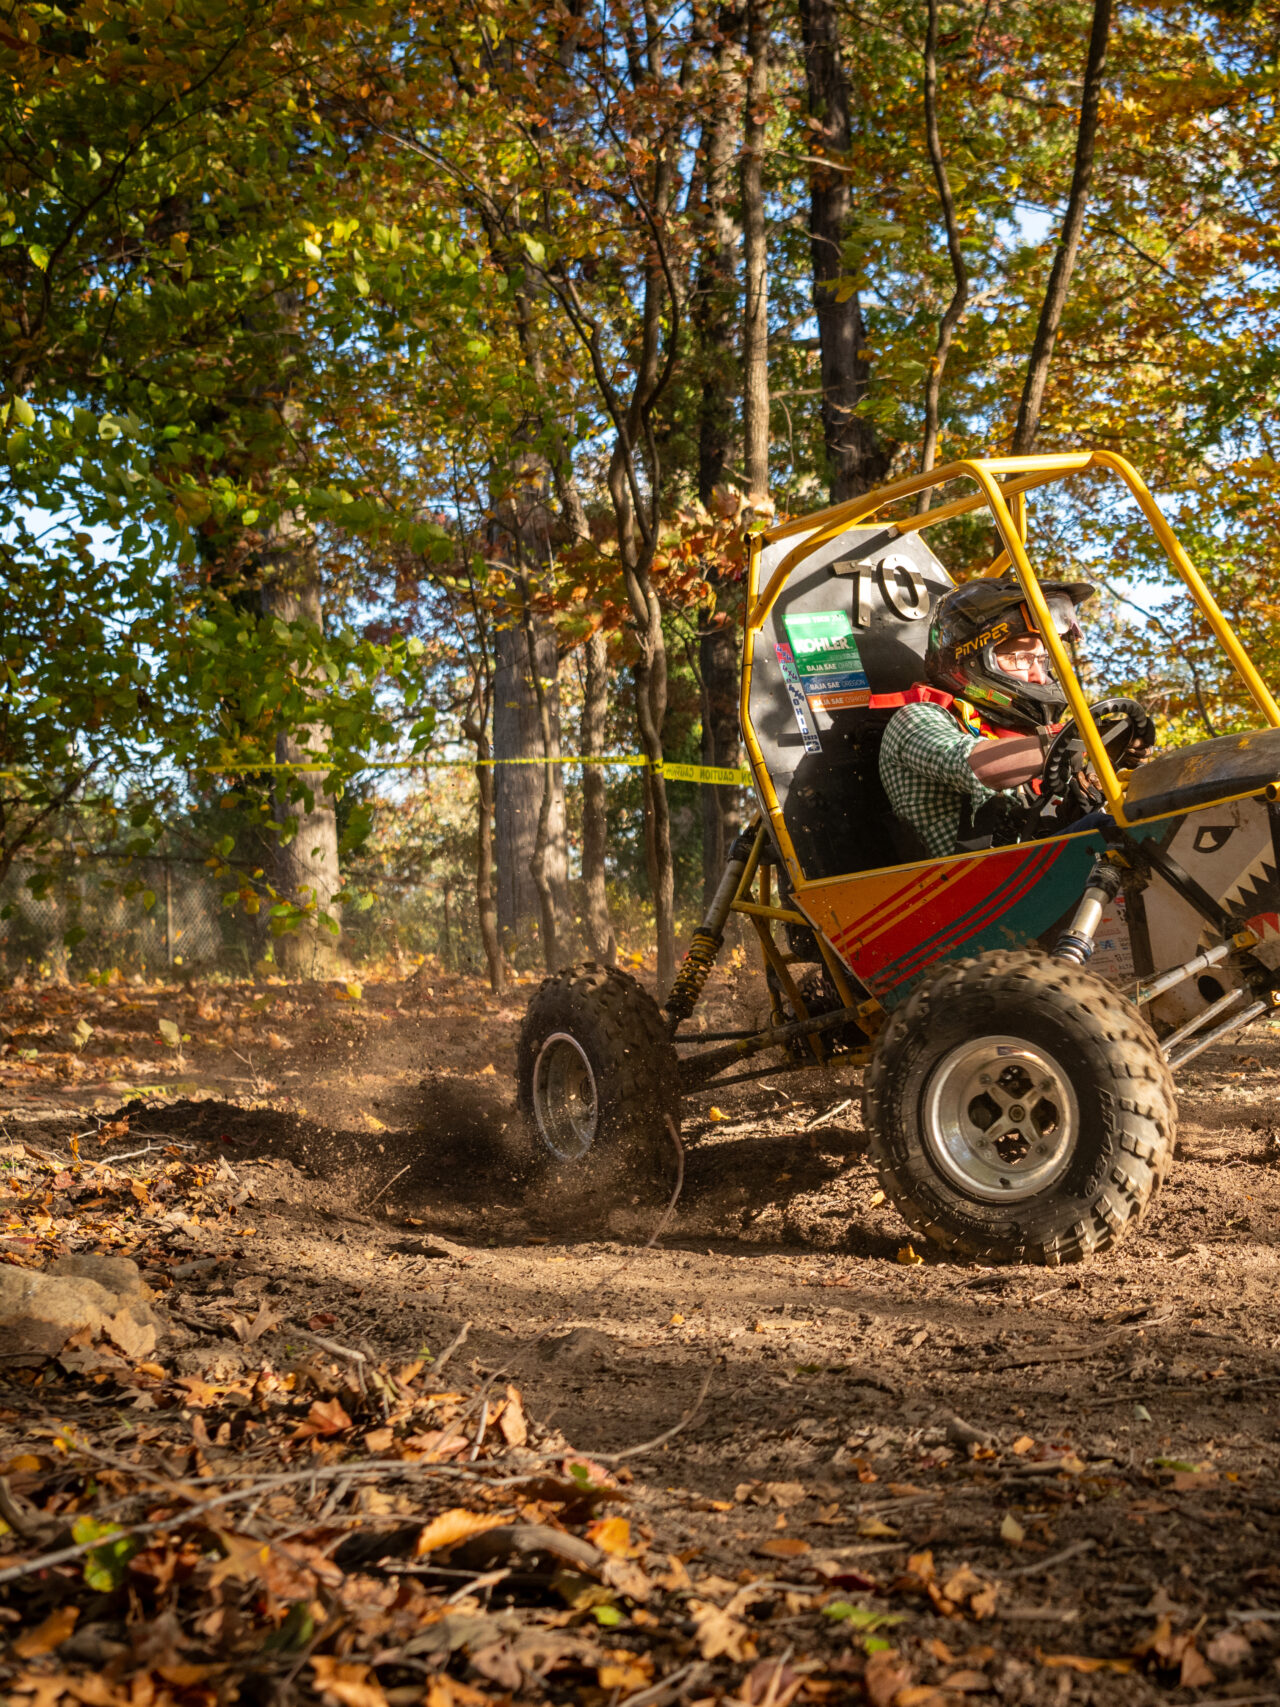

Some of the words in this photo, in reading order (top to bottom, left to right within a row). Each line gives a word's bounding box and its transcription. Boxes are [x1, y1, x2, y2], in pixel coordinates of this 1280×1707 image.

[833, 553, 930, 628] 70
[793, 635, 851, 654] KOHLER
[806, 663, 824, 672] BAJA
[810, 682, 827, 690] BAJA
[827, 681, 840, 689] SAE
[813, 698, 830, 706] BAJA
[793, 698, 809, 735] OHIO
